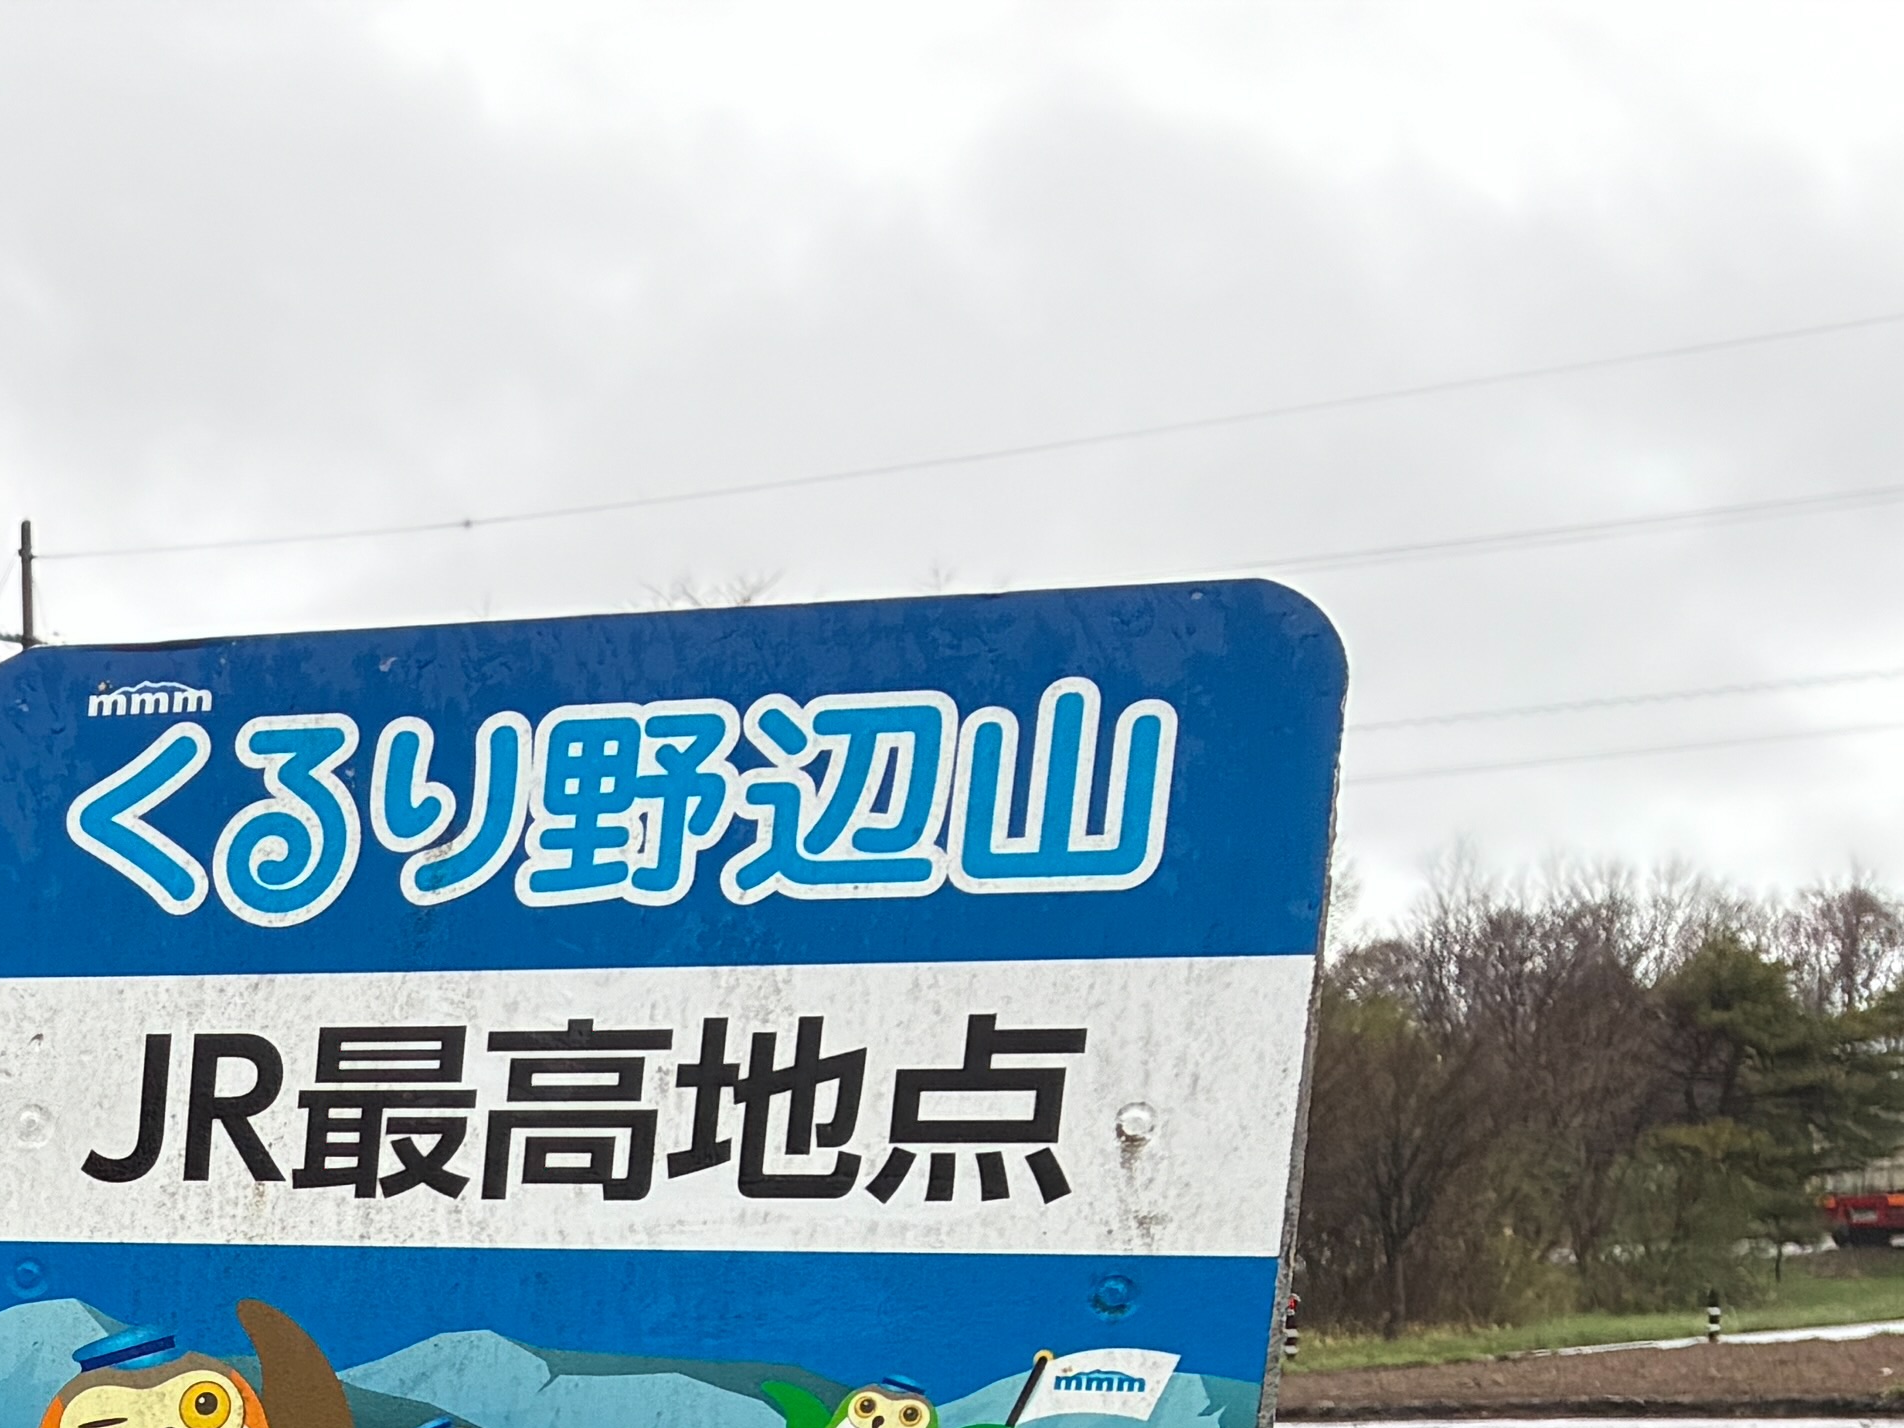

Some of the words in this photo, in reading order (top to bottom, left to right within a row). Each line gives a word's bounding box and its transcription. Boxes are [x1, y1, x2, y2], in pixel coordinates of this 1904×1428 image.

[65, 675, 1180, 929] くるり野辺山
[81, 1013, 1088, 1205] JR最高地点
